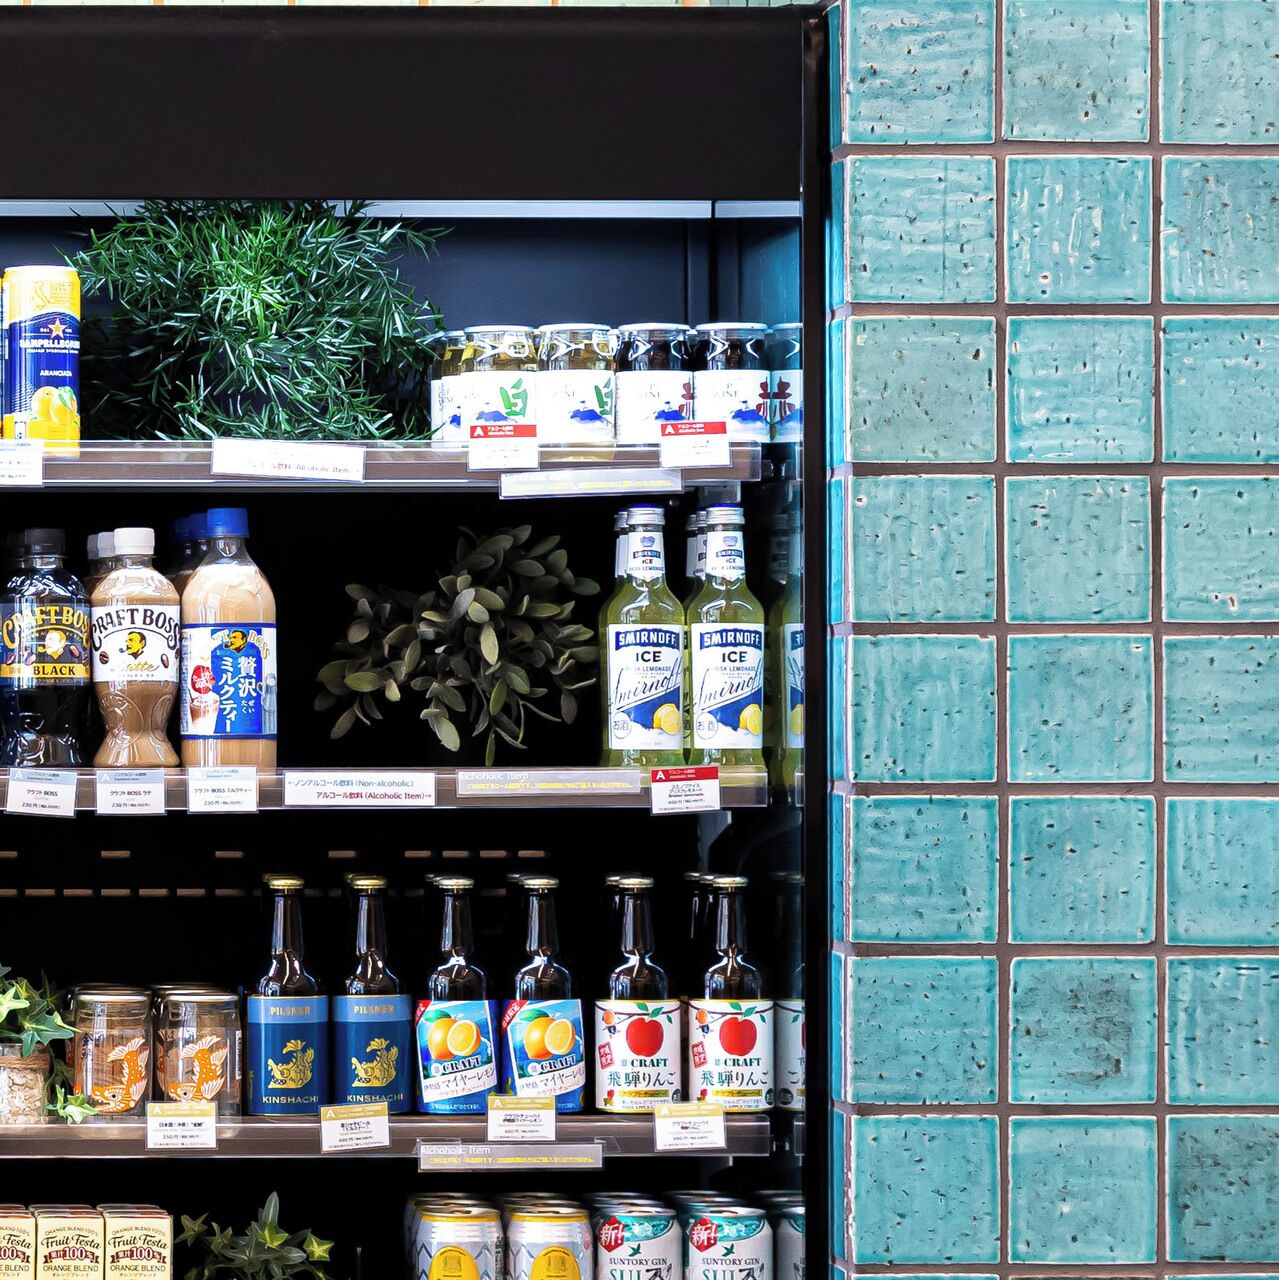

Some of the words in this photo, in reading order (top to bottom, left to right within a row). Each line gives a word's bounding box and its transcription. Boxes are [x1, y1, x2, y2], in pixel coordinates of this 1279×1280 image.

[2, 606, 60, 650] CRAFT
[91, 608, 139, 651] CRAFT
[142, 608, 181, 654] BOSS
[619, 631, 676, 646] SMIRNOFF
[704, 631, 761, 646] SMIRNOFF
[249, 630, 271, 661] BOSS
[636, 651, 662, 663] ICE
[722, 651, 748, 663] ICE
[33, 665, 75, 676] BLACK
[238, 656, 257, 697] 贅沢
[219, 656, 238, 734] ミルクティー
[294, 779, 355, 788] ノンアルコール飲料
[316, 791, 363, 800] アルコール飲料
[270, 1006, 311, 1016] PILSNER
[353, 1005, 395, 1014] PILSNER
[442, 1055, 482, 1073] CRAFT
[540, 1054, 576, 1072] CRAFT
[630, 1058, 669, 1067] CRAFT
[724, 1058, 762, 1067] CRAFT
[608, 1071, 677, 1088] 飛騨りんご
[700, 1071, 769, 1088] 飛騨りんご
[262, 1095, 319, 1104] KINSHACHI
[346, 1094, 404, 1103] KINSHACHI
[469, 1145, 491, 1155] Item
[2, 1233, 33, 1249] Festa
[41, 1234, 71, 1248] Fruit
[71, 1232, 102, 1250] Festa
[108, 1234, 138, 1248] Fruit
[138, 1232, 169, 1250] Festa
[609, 1257, 651, 1266] SUNTORY
[651, 1257, 667, 1266] GIN
[702, 1257, 743, 1266] SUNTORY
[744, 1257, 760, 1266] GIN
[43, 1264, 72, 1272] ORANGE
[74, 1264, 99, 1272] BLEND
[110, 1264, 139, 1272] ORANGE
[141, 1264, 166, 1272] BLEND
